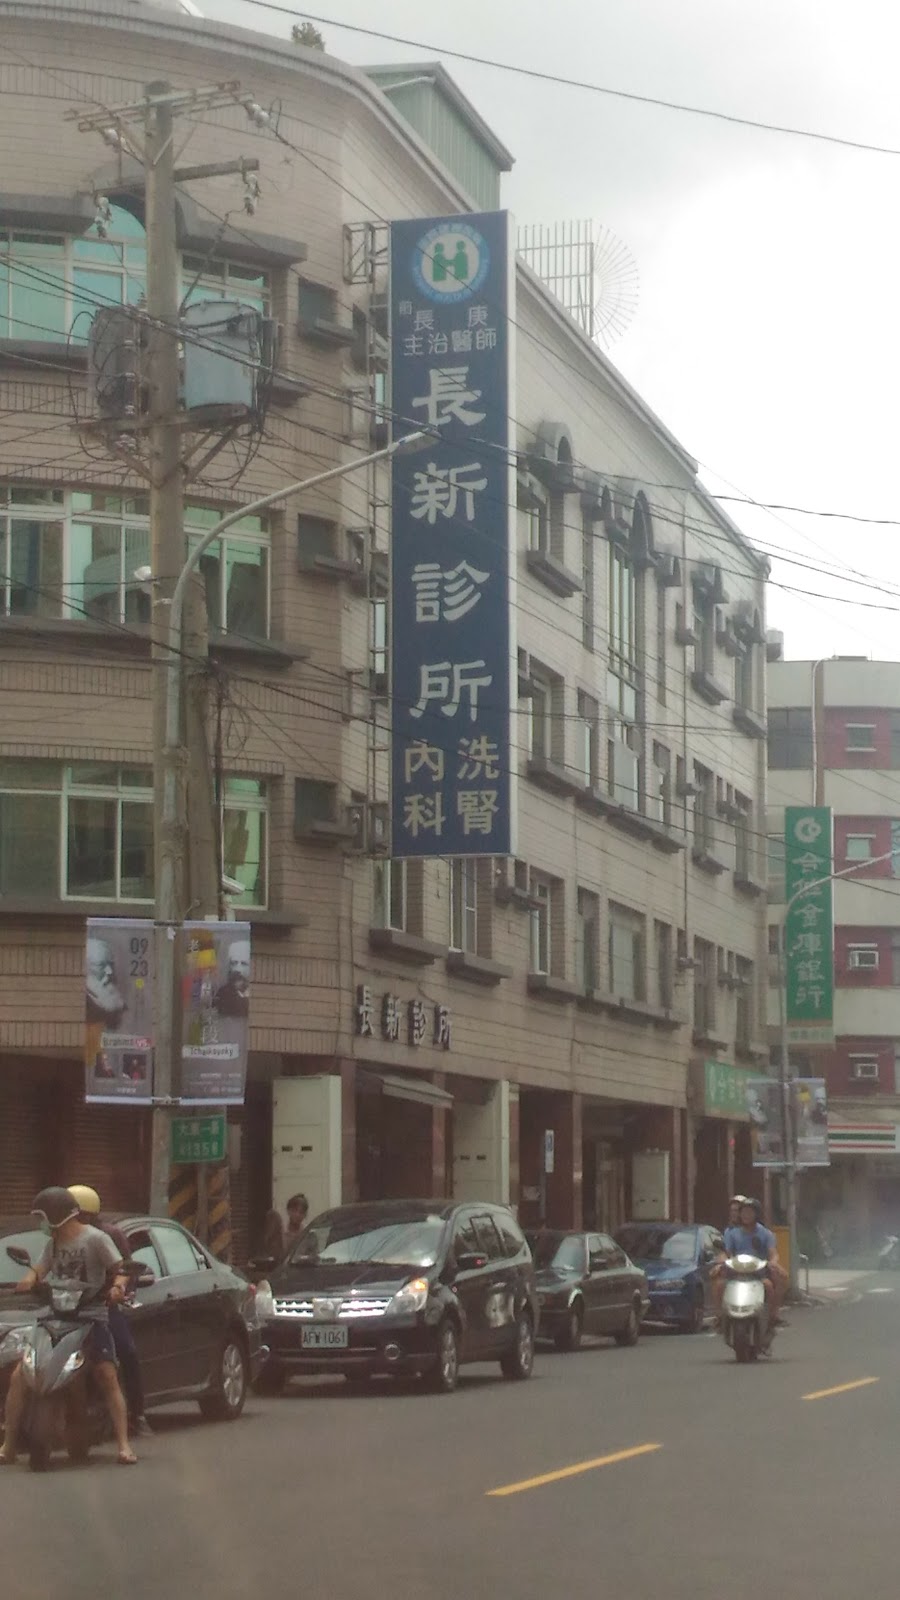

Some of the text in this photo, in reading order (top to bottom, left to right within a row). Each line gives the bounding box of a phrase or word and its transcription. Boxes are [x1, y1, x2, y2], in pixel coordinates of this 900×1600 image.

[404, 328, 496, 356] 主治醫師
[410, 366, 492, 722] 長新診所
[457, 736, 500, 836] 洗腎
[357, 984, 451, 1050] 長新診所
